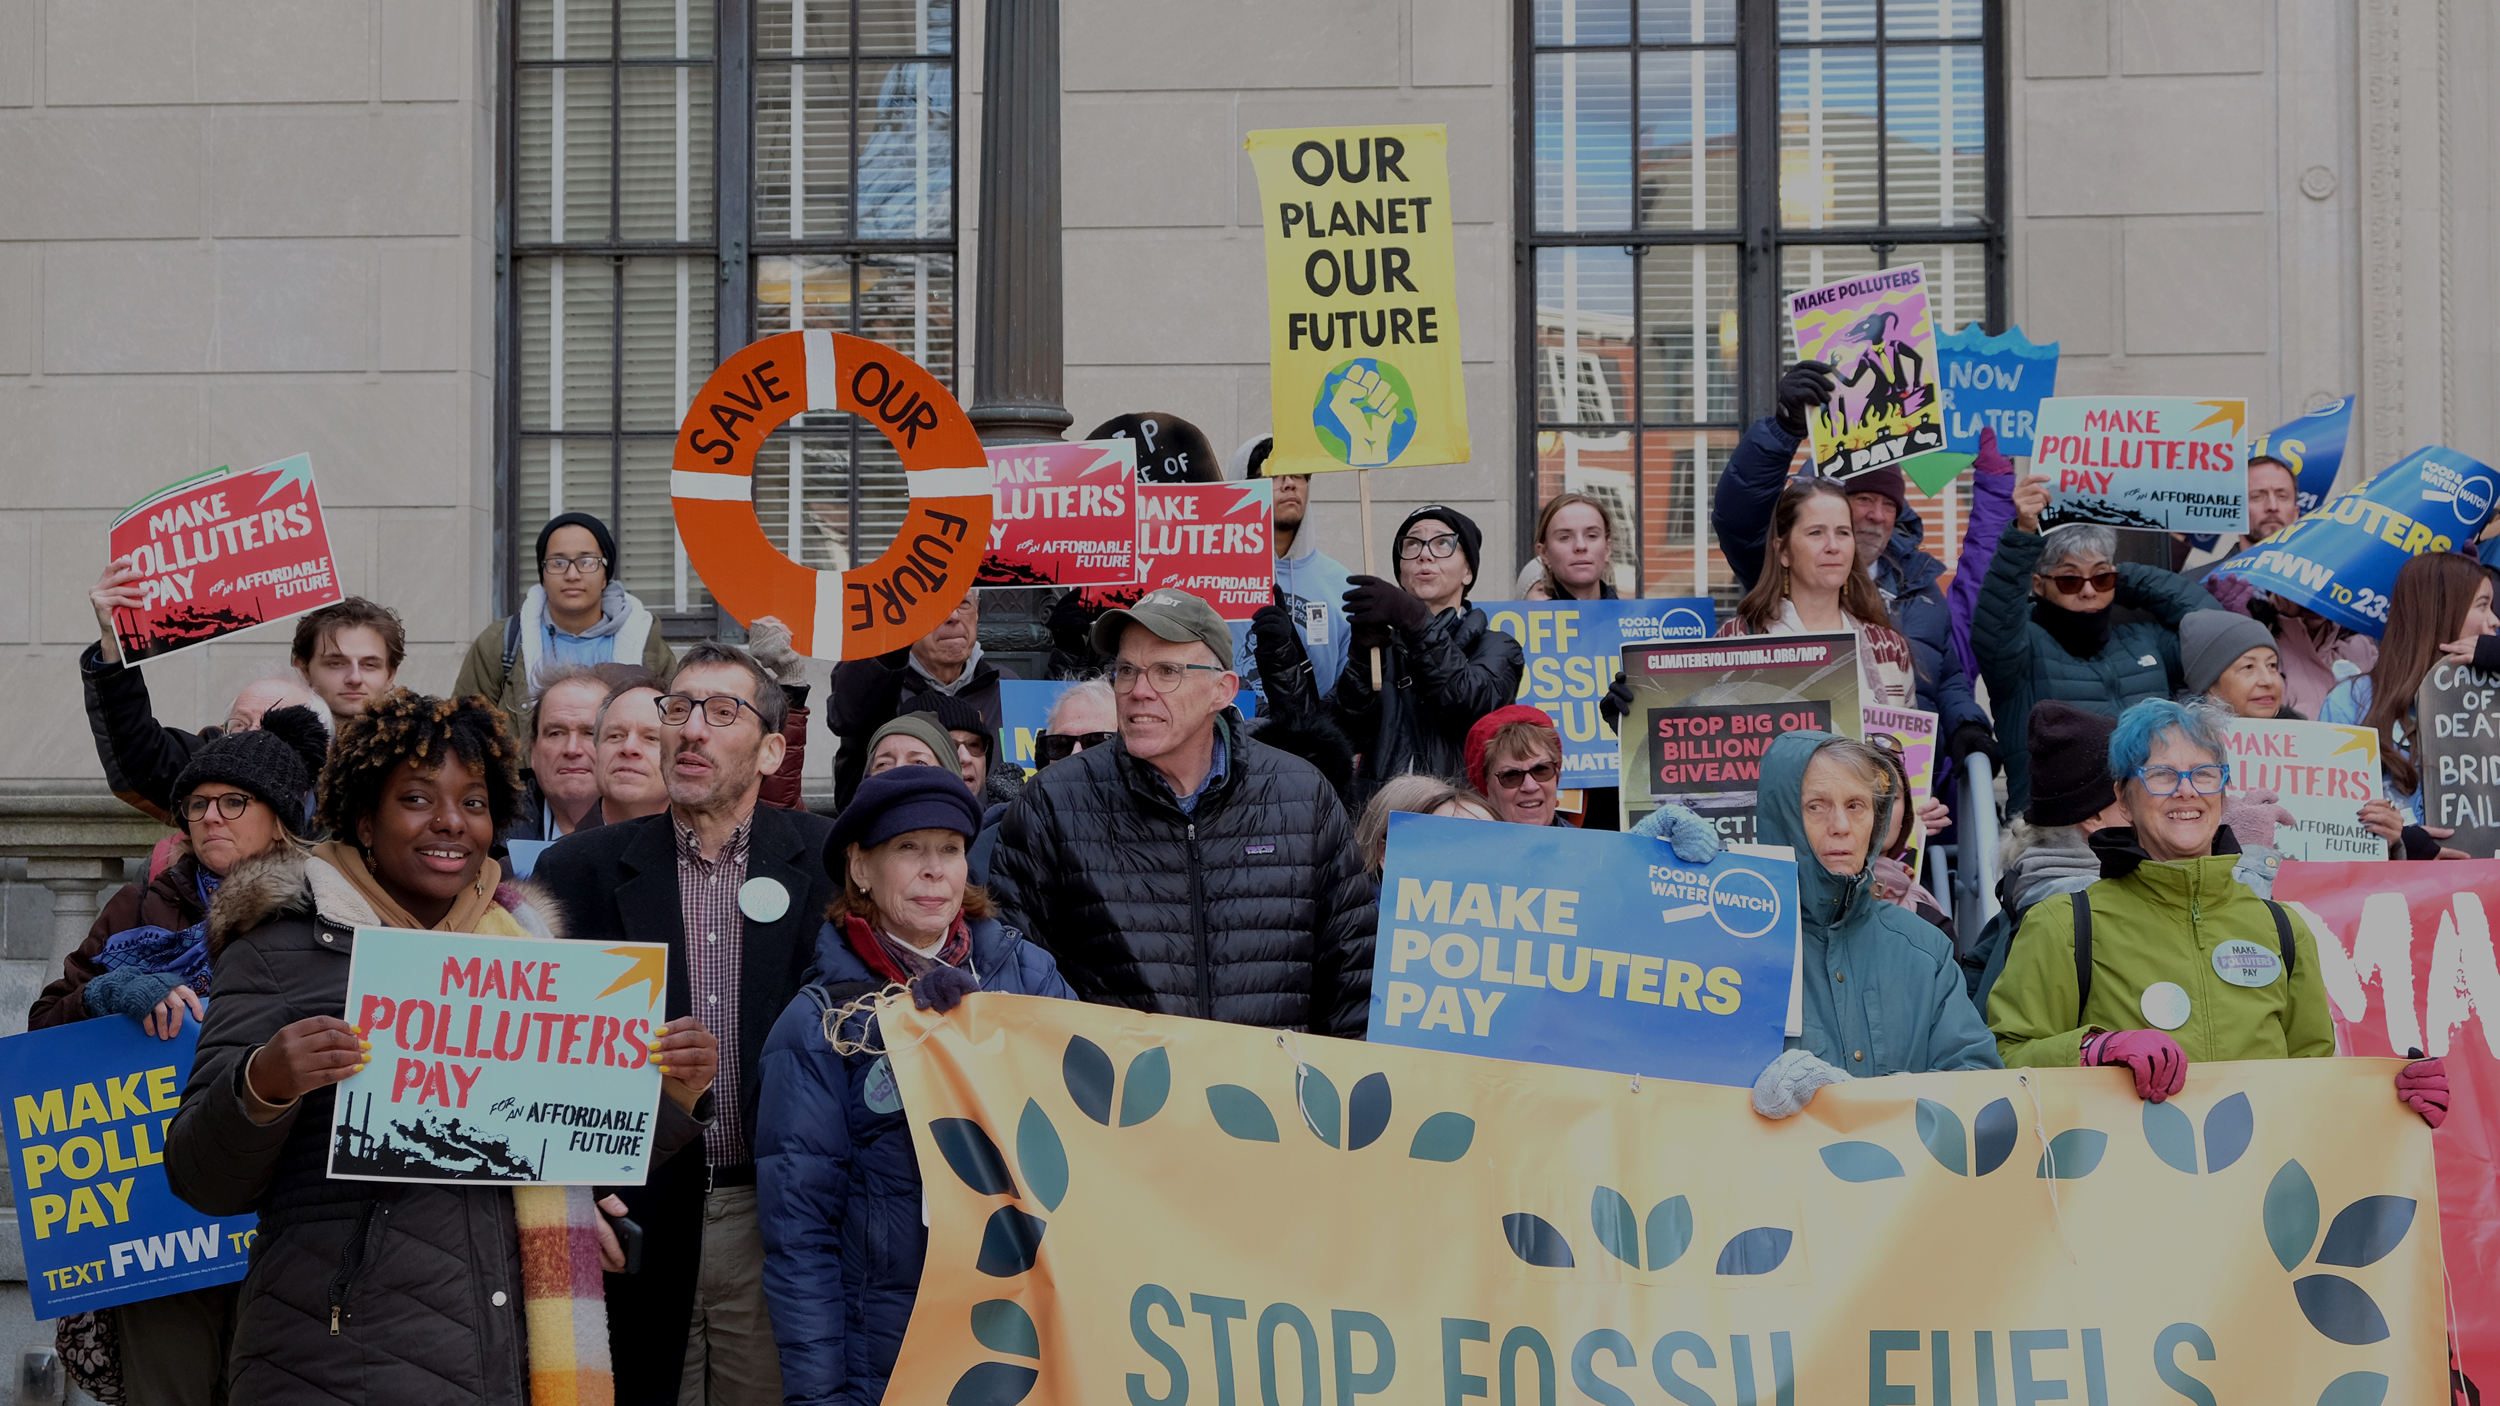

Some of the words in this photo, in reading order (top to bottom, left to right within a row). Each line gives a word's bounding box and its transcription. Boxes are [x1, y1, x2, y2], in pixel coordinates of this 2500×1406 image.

[1292, 137, 1410, 187] OUR
[1280, 197, 1432, 238] PLANET
[1305, 247, 1420, 298] OUR
[1794, 288, 1837, 313] MAKE
[1839, 269, 1922, 301] POLLUTERS
[1288, 307, 1439, 352] FUTURE
[1950, 361, 2024, 391] NOW
[690, 360, 790, 465] SAVE
[851, 362, 938, 450] OUR
[2084, 409, 2161, 434] MAKE
[1953, 409, 2036, 442] LATER
[1164, 452, 1189, 475] OF
[1850, 436, 1909, 472] PAY
[2038, 436, 2234, 472] POLLUTERS
[2060, 470, 2115, 496] PAY
[2124, 488, 2142, 498] FOR
[2150, 490, 2242, 508] AFFORDABLE
[2421, 470, 2458, 494] WATER
[2459, 488, 2490, 511] WATCH
[149, 492, 231, 540] MAKE
[2185, 505, 2241, 520] FUTURE
[114, 502, 312, 577] OLLUTERS
[1016, 539, 1034, 552] FOR
[1027, 544, 1040, 555] AN
[1042, 540, 1132, 554] AFFORDABLE
[1138, 522, 1264, 555] LUTERS
[209, 579, 225, 597] FOR
[222, 582, 234, 597] AN
[236, 556, 330, 592] AFFORDABLE
[846, 509, 968, 632] FUTURE
[1075, 554, 1130, 568] FUTURE
[2221, 557, 2256, 571] TEXT
[2252, 550, 2335, 592] FWW
[2330, 582, 2353, 605] TO
[139, 569, 195, 612] PAY
[274, 572, 332, 599] FUTURE
[1162, 574, 1178, 586] FOR
[1172, 578, 1185, 588] AN
[1186, 575, 1270, 591] AFFORDABLE
[1218, 590, 1270, 604] FUTURE
[1489, 610, 1580, 654] OFF
[1620, 627, 1660, 638] WATER
[1662, 626, 1702, 637] WATCH
[1647, 646, 1828, 670] CLIMATEREVOLUTIONNJ.ORG/MPP
[2463, 690, 2495, 711] OF
[1658, 717, 1724, 738] STOP
[1731, 714, 1773, 735] BIG
[1779, 710, 1823, 734] OIL
[1863, 709, 1933, 735] OLLUTERS
[2222, 731, 2299, 758] MAKE
[1661, 761, 1761, 784] GIVEAW
[2225, 760, 2371, 801] LUTERS
[2325, 837, 2380, 856] FUTURE
[1395, 877, 1580, 937] MAKE
[1650, 880, 1708, 903] WATER
[1714, 890, 1775, 914] WATCH
[2221, 956, 2273, 967] POLLUTERS
[2232, 946, 2257, 955] MAKE
[440, 956, 561, 1002] MAKE
[1390, 928, 1742, 1016] POLLUTERS
[2242, 968, 2258, 977] PAY
[1384, 981, 1507, 1037] PAY
[357, 994, 650, 1070] POLLUTERS
[391, 1057, 482, 1109] PAY
[13, 1065, 181, 1140] MAKE
[489, 1096, 516, 1116] FOR
[505, 1104, 525, 1122] AN
[526, 1101, 650, 1133] AFFORDABLE
[568, 1130, 645, 1157] FUTURE
[29, 1177, 135, 1240] PAY
[42, 1260, 106, 1292] TEXT
[109, 1223, 220, 1278] FWW
[1125, 1283, 1396, 1406] STOP
